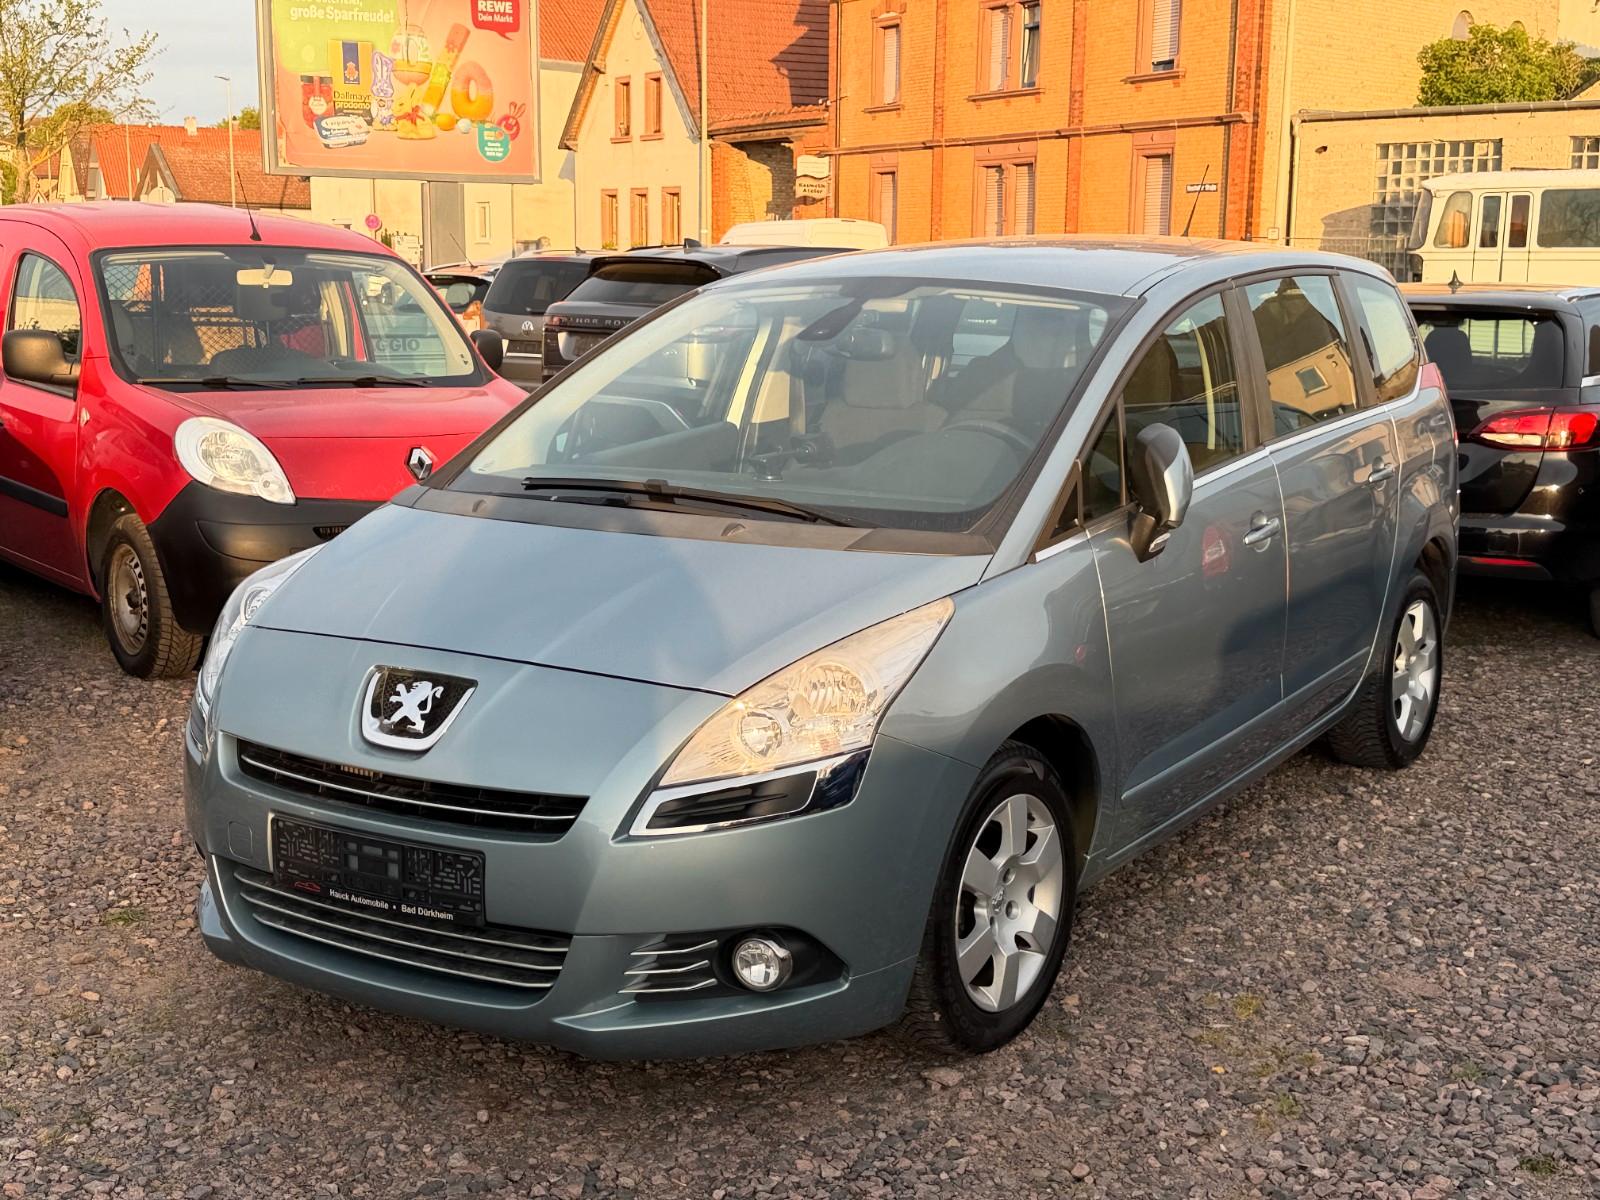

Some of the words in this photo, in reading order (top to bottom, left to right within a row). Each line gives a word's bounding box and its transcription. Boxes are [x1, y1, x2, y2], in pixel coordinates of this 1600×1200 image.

[478, 0, 513, 13] REWE
[291, 5, 324, 20] große
[326, 6, 394, 23] Sparfreude!
[478, 13, 493, 22] Dein
[494, 14, 513, 23] Markt
[334, 91, 371, 102] Dallmayr
[336, 101, 371, 110] prodomo
[375, 338, 421, 352] GGIO
[329, 888, 350, 901] Hauck
[351, 894, 389, 910] Automobile
[401, 904, 416, 915] Bad
[417, 907, 454, 921] Dürkheim
